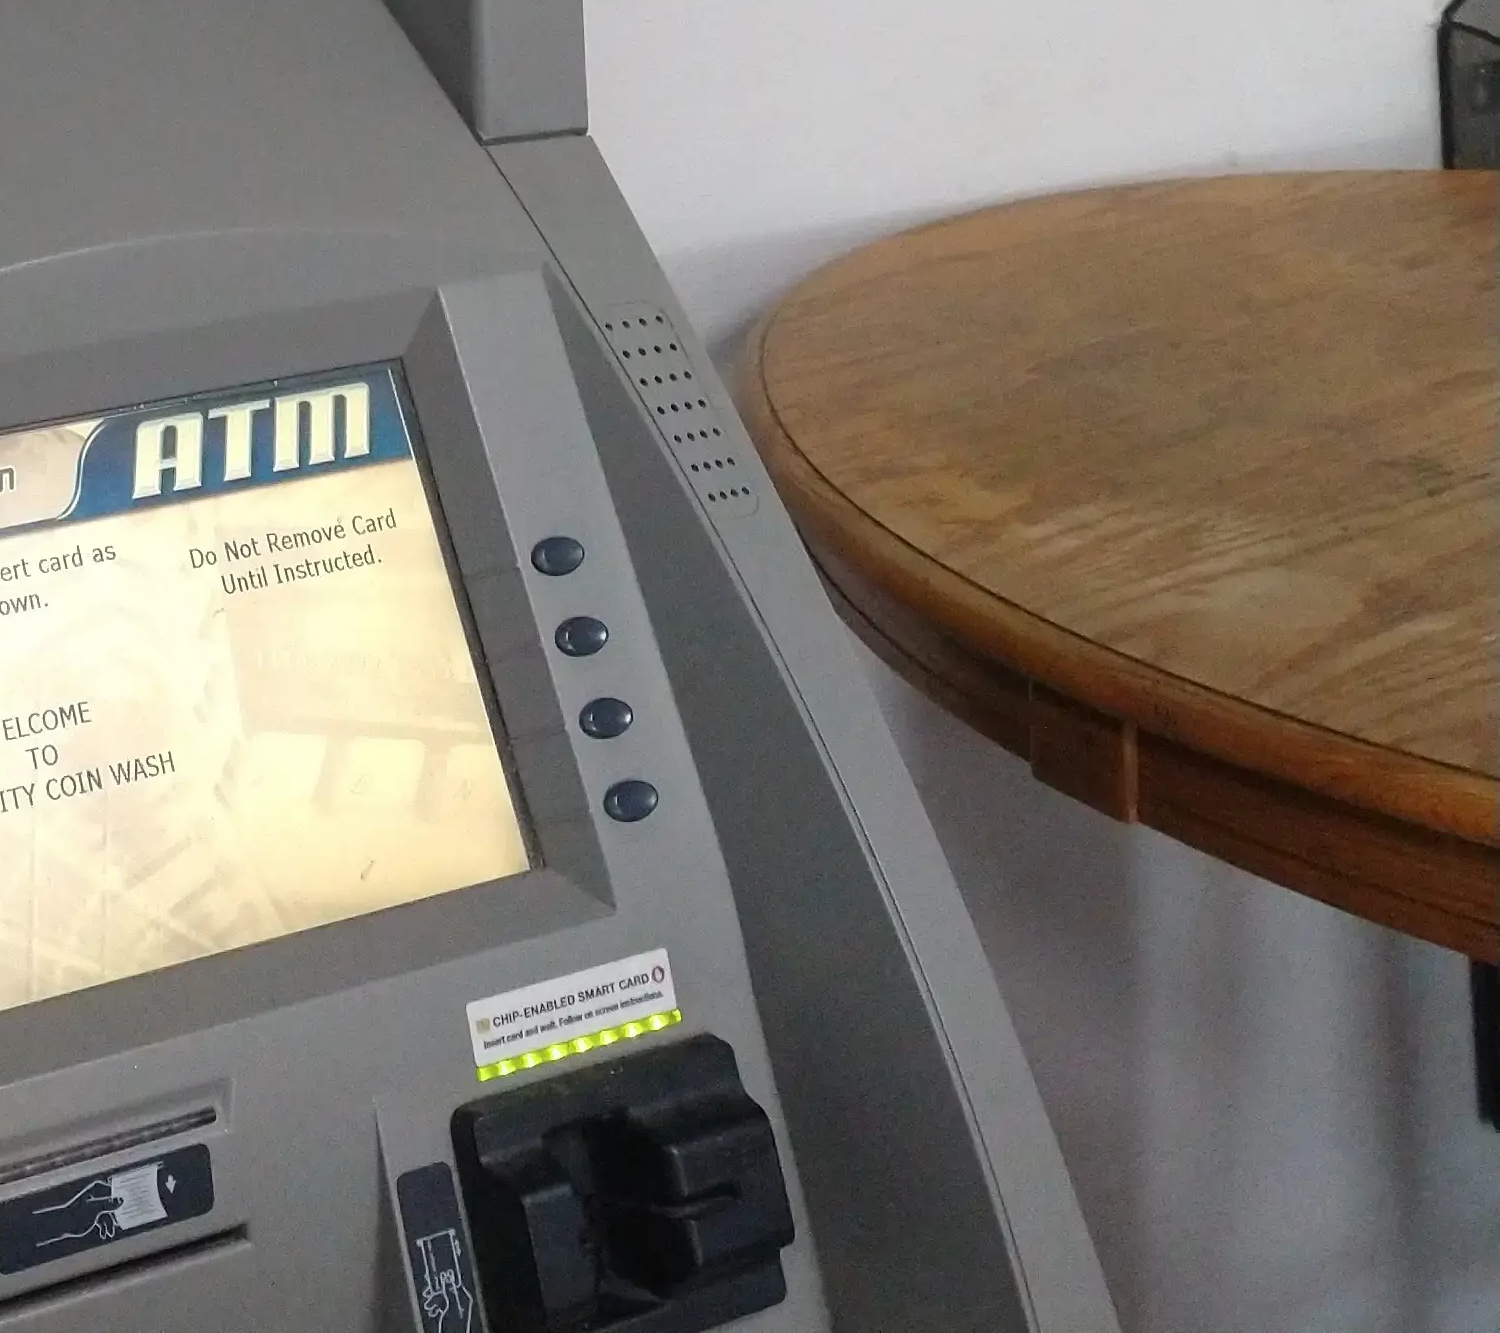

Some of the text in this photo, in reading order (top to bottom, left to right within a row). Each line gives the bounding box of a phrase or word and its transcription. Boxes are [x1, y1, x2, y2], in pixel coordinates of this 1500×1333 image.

[132, 381, 370, 500] ATM
[38, 544, 84, 574] card
[92, 544, 117, 563] as
[189, 507, 397, 569] Do Not Remove Card
[220, 544, 383, 595] Until Instructed.
[25, 744, 59, 770] TO
[45, 767, 103, 801] COIN
[108, 751, 176, 785] WASH
[492, 973, 650, 1028] CHIP-ENABLED SMART CARD
